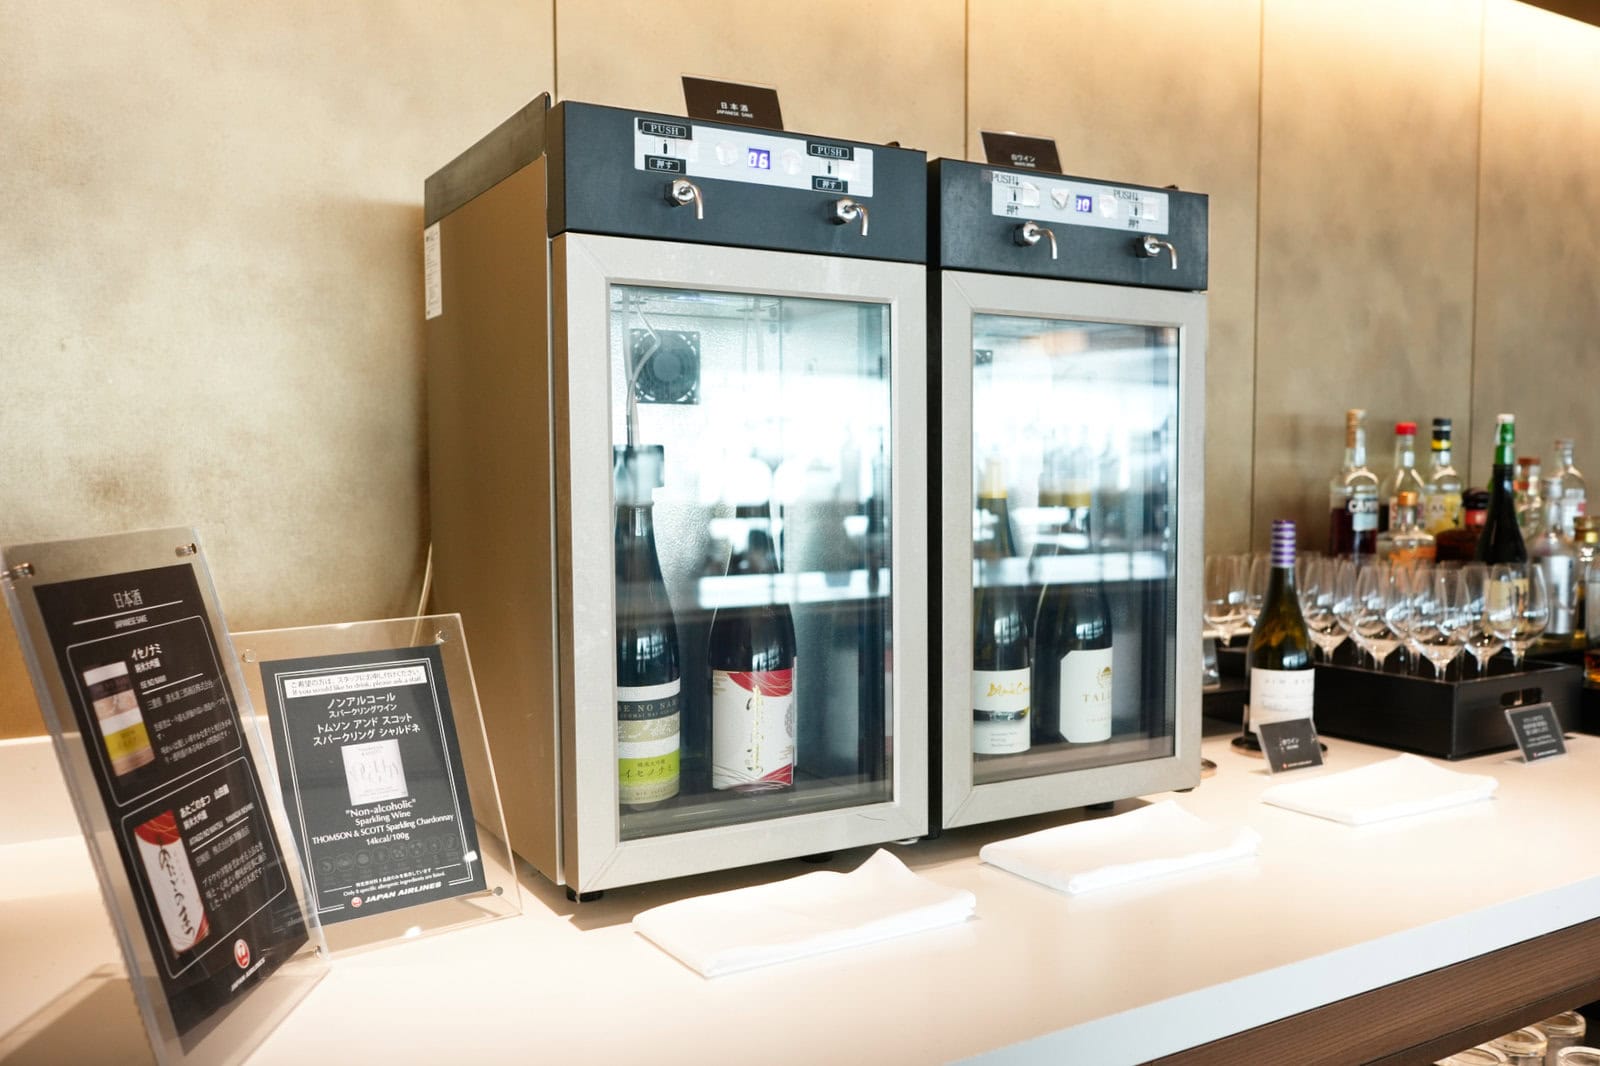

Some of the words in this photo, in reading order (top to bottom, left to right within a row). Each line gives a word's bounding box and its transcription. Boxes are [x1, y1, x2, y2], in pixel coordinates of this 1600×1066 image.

[720, 102, 748, 112] 日本酒
[651, 124, 679, 135] PUSH
[748, 151, 767, 168] 06
[817, 146, 842, 157] PUSH
[657, 159, 673, 169] 押す
[822, 180, 836, 189] 押す
[992, 172, 1015, 185] PUSH
[1113, 189, 1135, 200] PUSH
[113, 588, 143, 609] 日本酒
[131, 643, 162, 661] イセノナミ
[327, 692, 396, 709] ノンアルコール
[329, 704, 397, 718] スパークリングワイン
[317, 721, 350, 733] トムソン
[353, 716, 378, 729] アンド
[382, 712, 412, 725] スコット
[313, 729, 375, 746] スパークリング
[379, 723, 420, 737] シャルドネ
[345, 799, 416, 818] "Non-alcoholic"
[355, 815, 390, 827] Sparkling
[391, 811, 411, 819] Wine
[312, 831, 352, 845] THOMSON
[354, 830, 360, 838] &
[361, 825, 385, 836] SCOTT
[386, 820, 416, 831] Sparkling
[417, 814, 454, 825] Chardonnay
[366, 833, 410, 846] 14kcal/100g
[365, 891, 396, 903] JAPAN
[398, 882, 442, 896] AIRLINES
